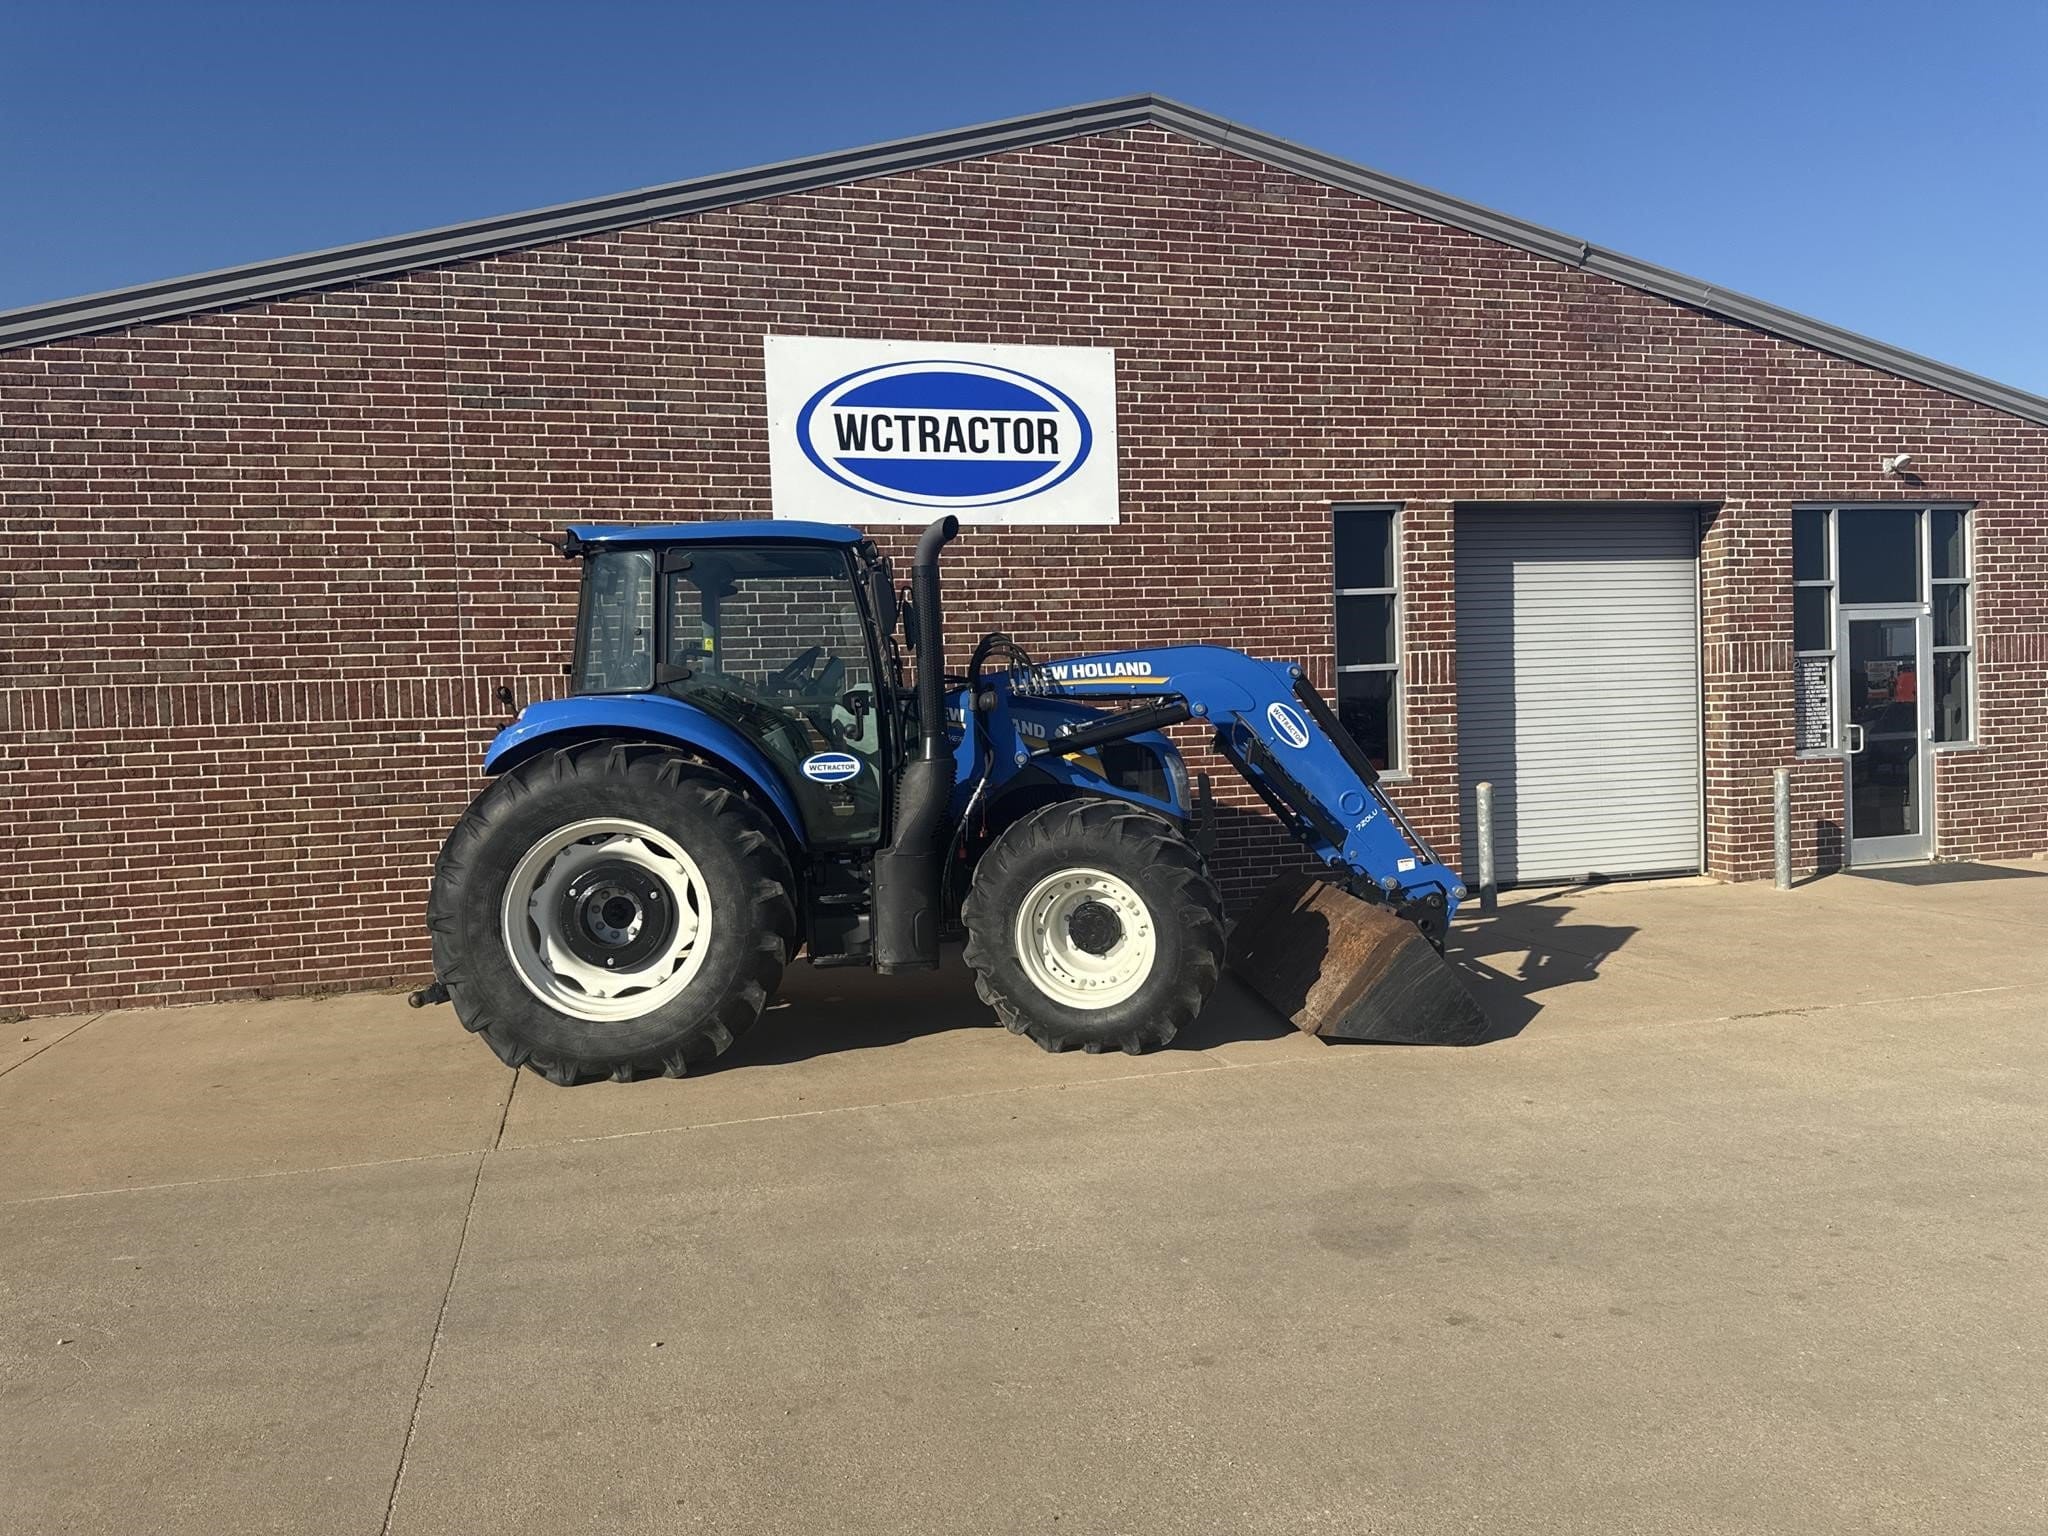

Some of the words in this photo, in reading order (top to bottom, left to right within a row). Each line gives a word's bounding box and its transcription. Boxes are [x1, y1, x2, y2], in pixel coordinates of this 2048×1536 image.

[834, 413, 1059, 455] WCTRACTOR
[1072, 661, 1152, 680] HOLLAND
[1273, 707, 1304, 744] WCTRACTOR
[809, 763, 856, 772] WCTRACTOR
